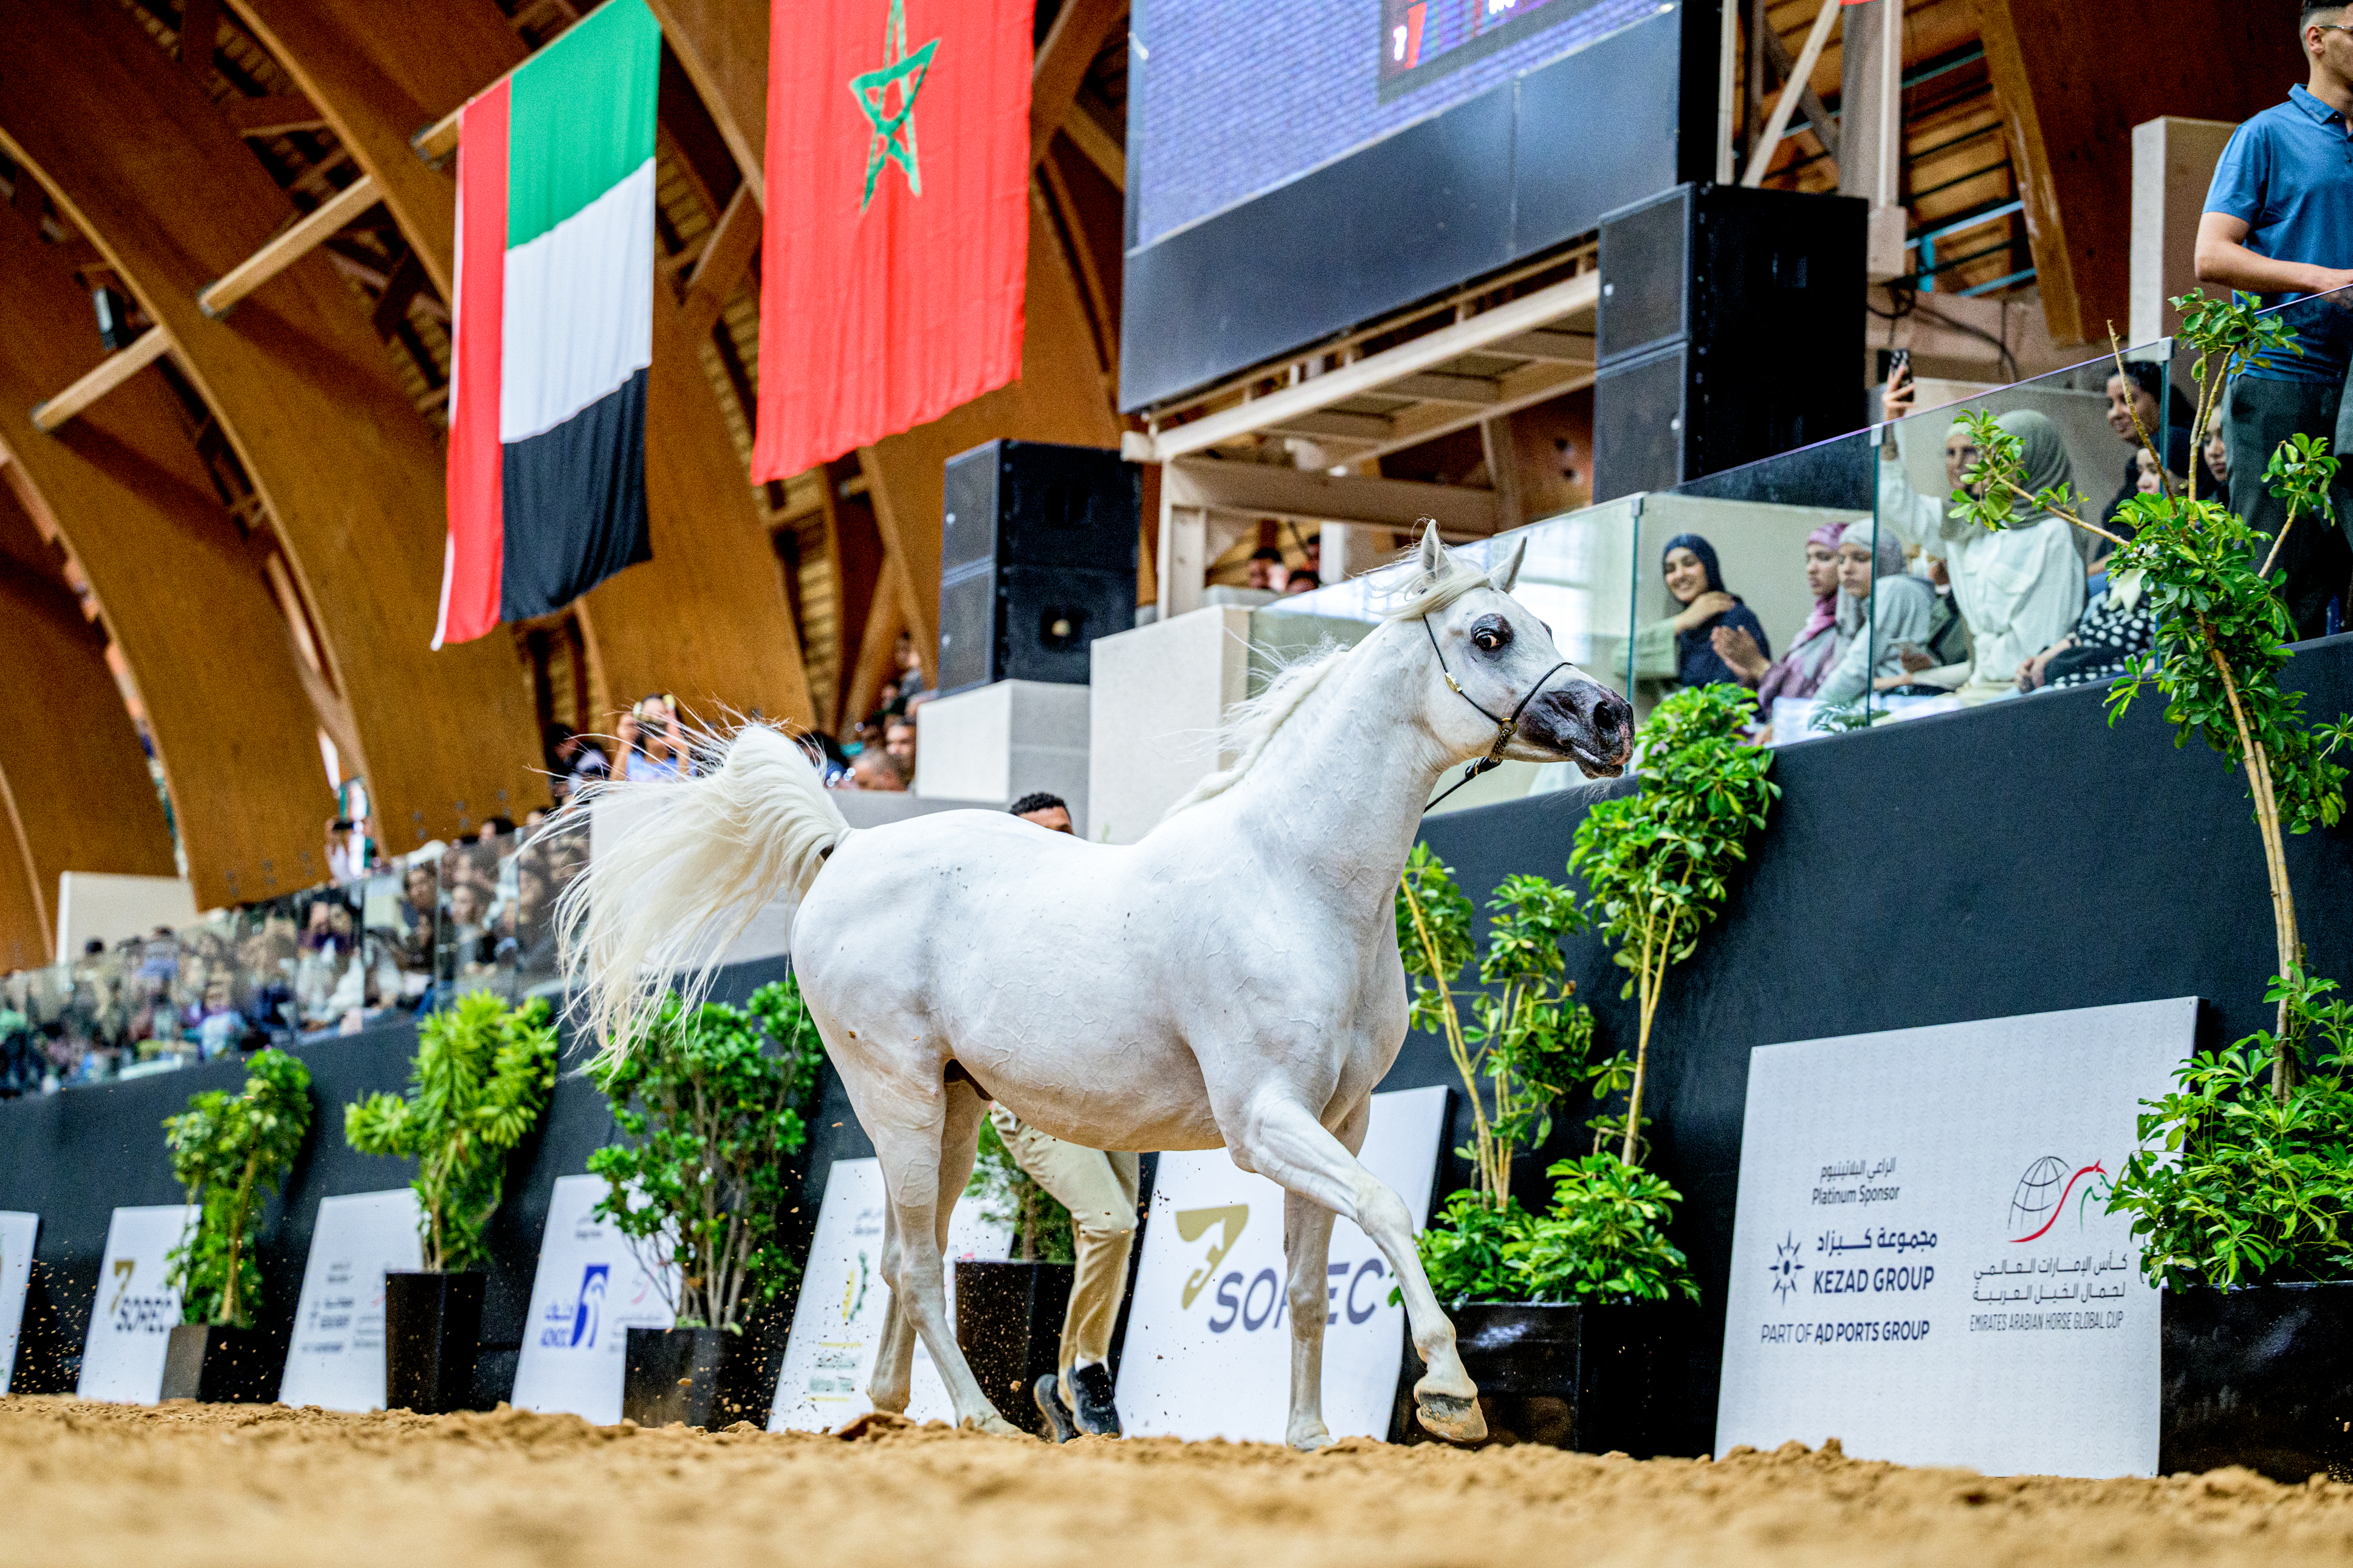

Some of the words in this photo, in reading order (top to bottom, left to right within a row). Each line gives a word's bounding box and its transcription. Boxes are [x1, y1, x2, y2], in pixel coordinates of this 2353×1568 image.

[1820, 1159, 1866, 1183] البلاتينيوم
[1866, 1157, 1897, 1183] الراعي
[1812, 1186, 1856, 1205] Platinum
[1859, 1184, 1900, 1207] Sponsor
[1817, 1228, 1872, 1257] كيزاد
[1877, 1227, 1937, 1253] مجموعة
[1974, 1258, 2036, 1285] العالمي
[2038, 1255, 2092, 1277] الإمارات
[2094, 1250, 2127, 1275] كأس
[1813, 1269, 1869, 1294] KEZAD
[1873, 1265, 1934, 1292] GROUP
[1973, 1284, 2033, 1306] العربية
[2035, 1282, 2078, 1304] الخيل
[2081, 1281, 2126, 1303] لجمال
[1761, 1323, 1793, 1343] PART
[1795, 1323, 1813, 1343] OF
[1814, 1323, 1834, 1343] AD
[1836, 1321, 1880, 1341] PORTS
[1883, 1320, 1930, 1341] GROUP
[1970, 1313, 2007, 1332] EMIRATES
[2008, 1312, 2044, 1331] ARABIAN
[2044, 1311, 2072, 1330] HORSE
[2073, 1310, 2104, 1329] GLOBAL
[2106, 1310, 2124, 1329] CUP
